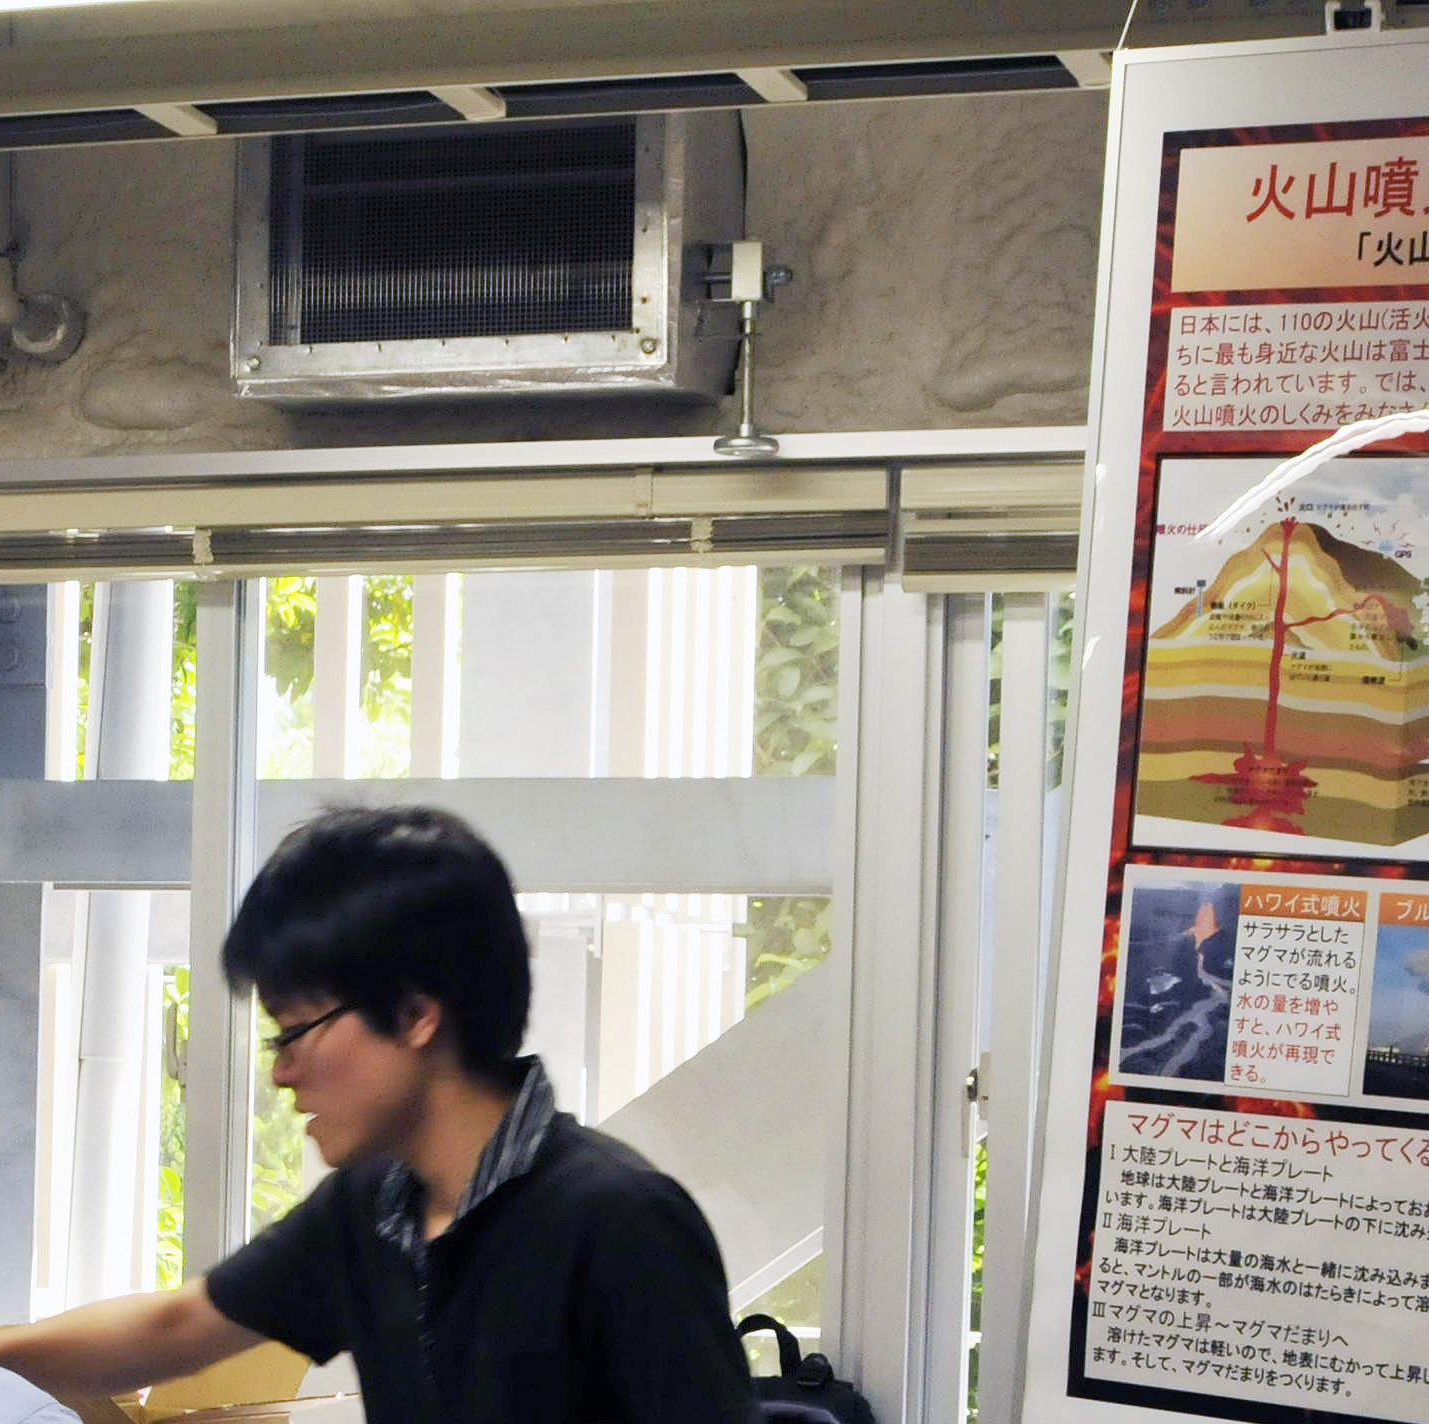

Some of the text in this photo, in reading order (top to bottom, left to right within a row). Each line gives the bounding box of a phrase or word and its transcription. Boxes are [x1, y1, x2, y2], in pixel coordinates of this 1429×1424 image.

[1246, 156, 1429, 222] 火山噴
[1245, 891, 1360, 919] ハワイ式噴火
[1242, 921, 1349, 945] サラサラとした
[1241, 945, 1357, 970] マグマが流れる
[1237, 970, 1356, 995] ようにでる噴火。
[1235, 994, 1340, 1018] 水の量を増や
[1233, 1017, 1342, 1042] すと、ハワイ式
[1231, 1041, 1336, 1065] 噴火が再現で
[1229, 1064, 1269, 1085] きる。
[1105, 1190, 1429, 1241] います。海洋プレートは大陸プレートの下に沈み
[1097, 1279, 1213, 1309] マグマとなります。
